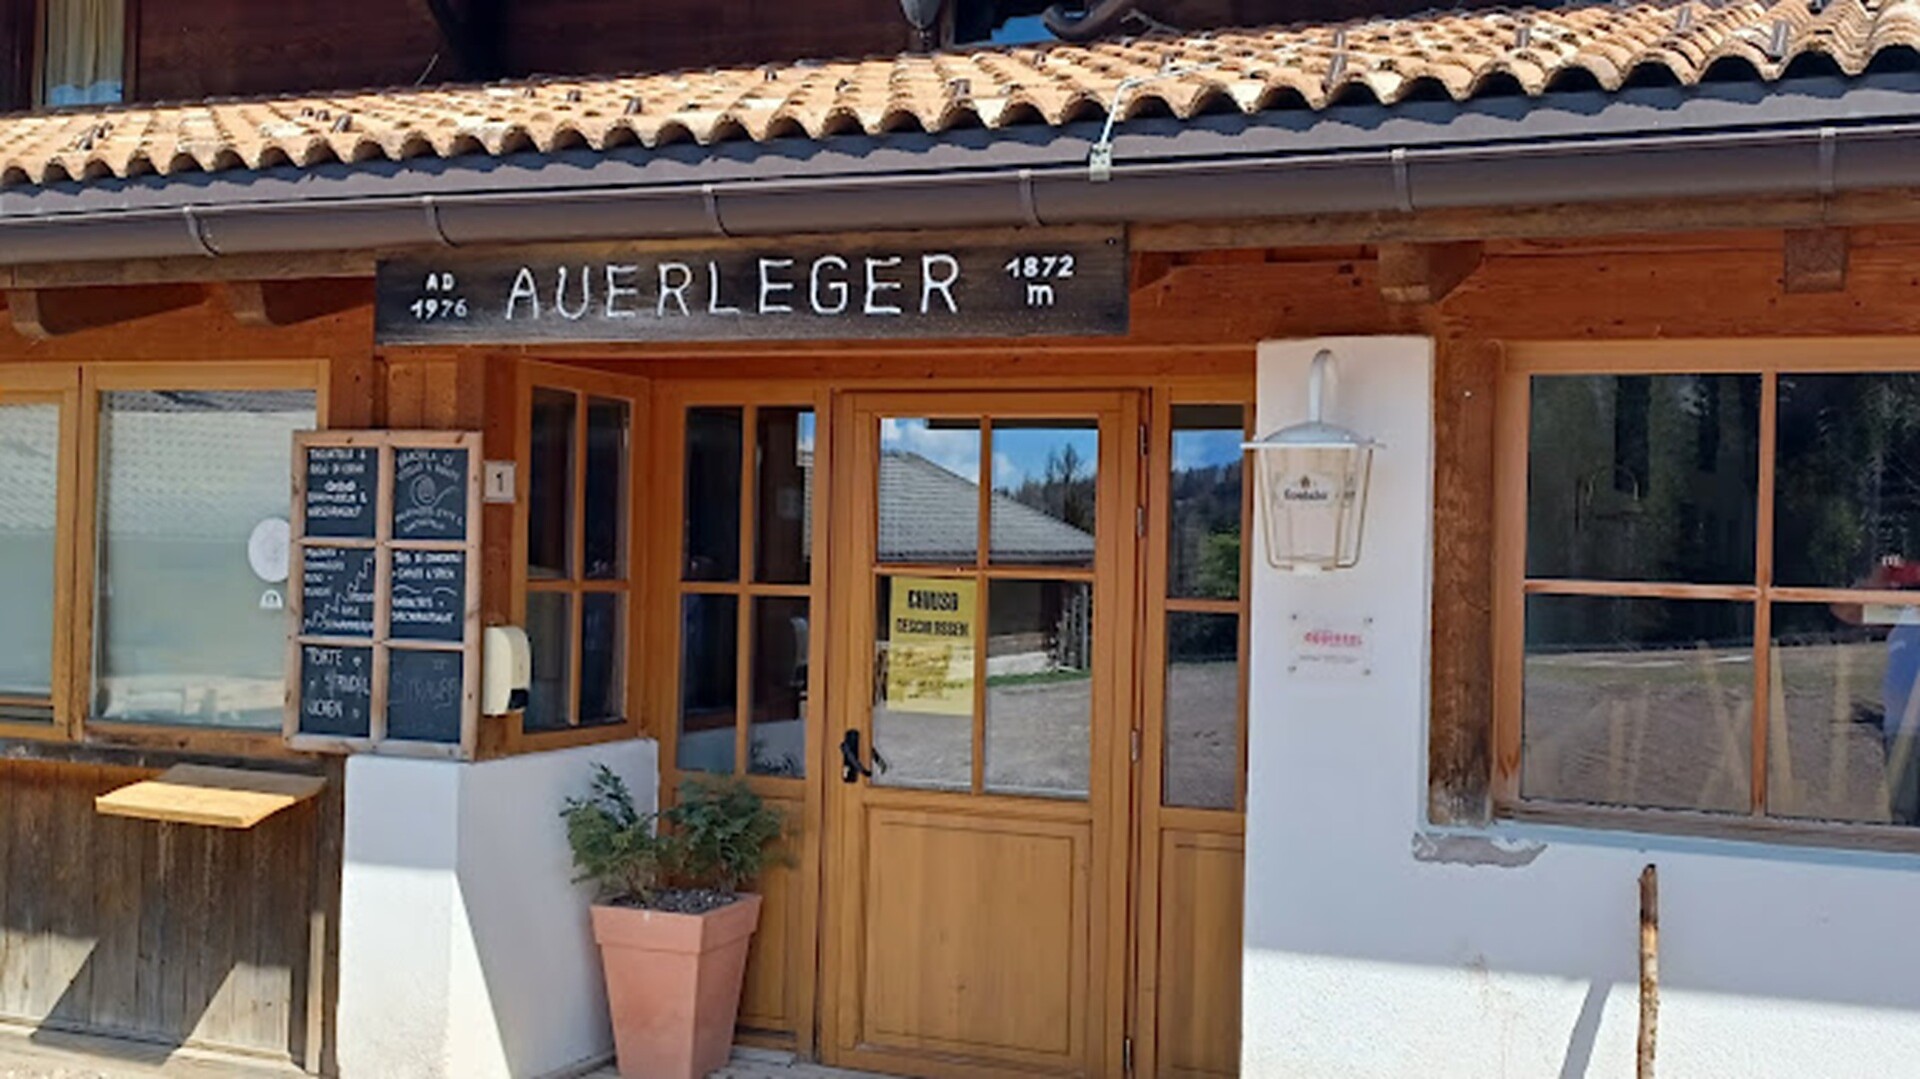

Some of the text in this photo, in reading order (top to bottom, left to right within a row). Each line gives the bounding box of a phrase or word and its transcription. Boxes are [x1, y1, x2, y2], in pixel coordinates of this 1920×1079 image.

[1004, 254, 1075, 278] 1872
[425, 273, 454, 292] AD
[505, 254, 960, 320] AUERLEGER
[1026, 282, 1054, 306] m
[410, 299, 468, 319] 1976
[496, 471, 503, 492] 1
